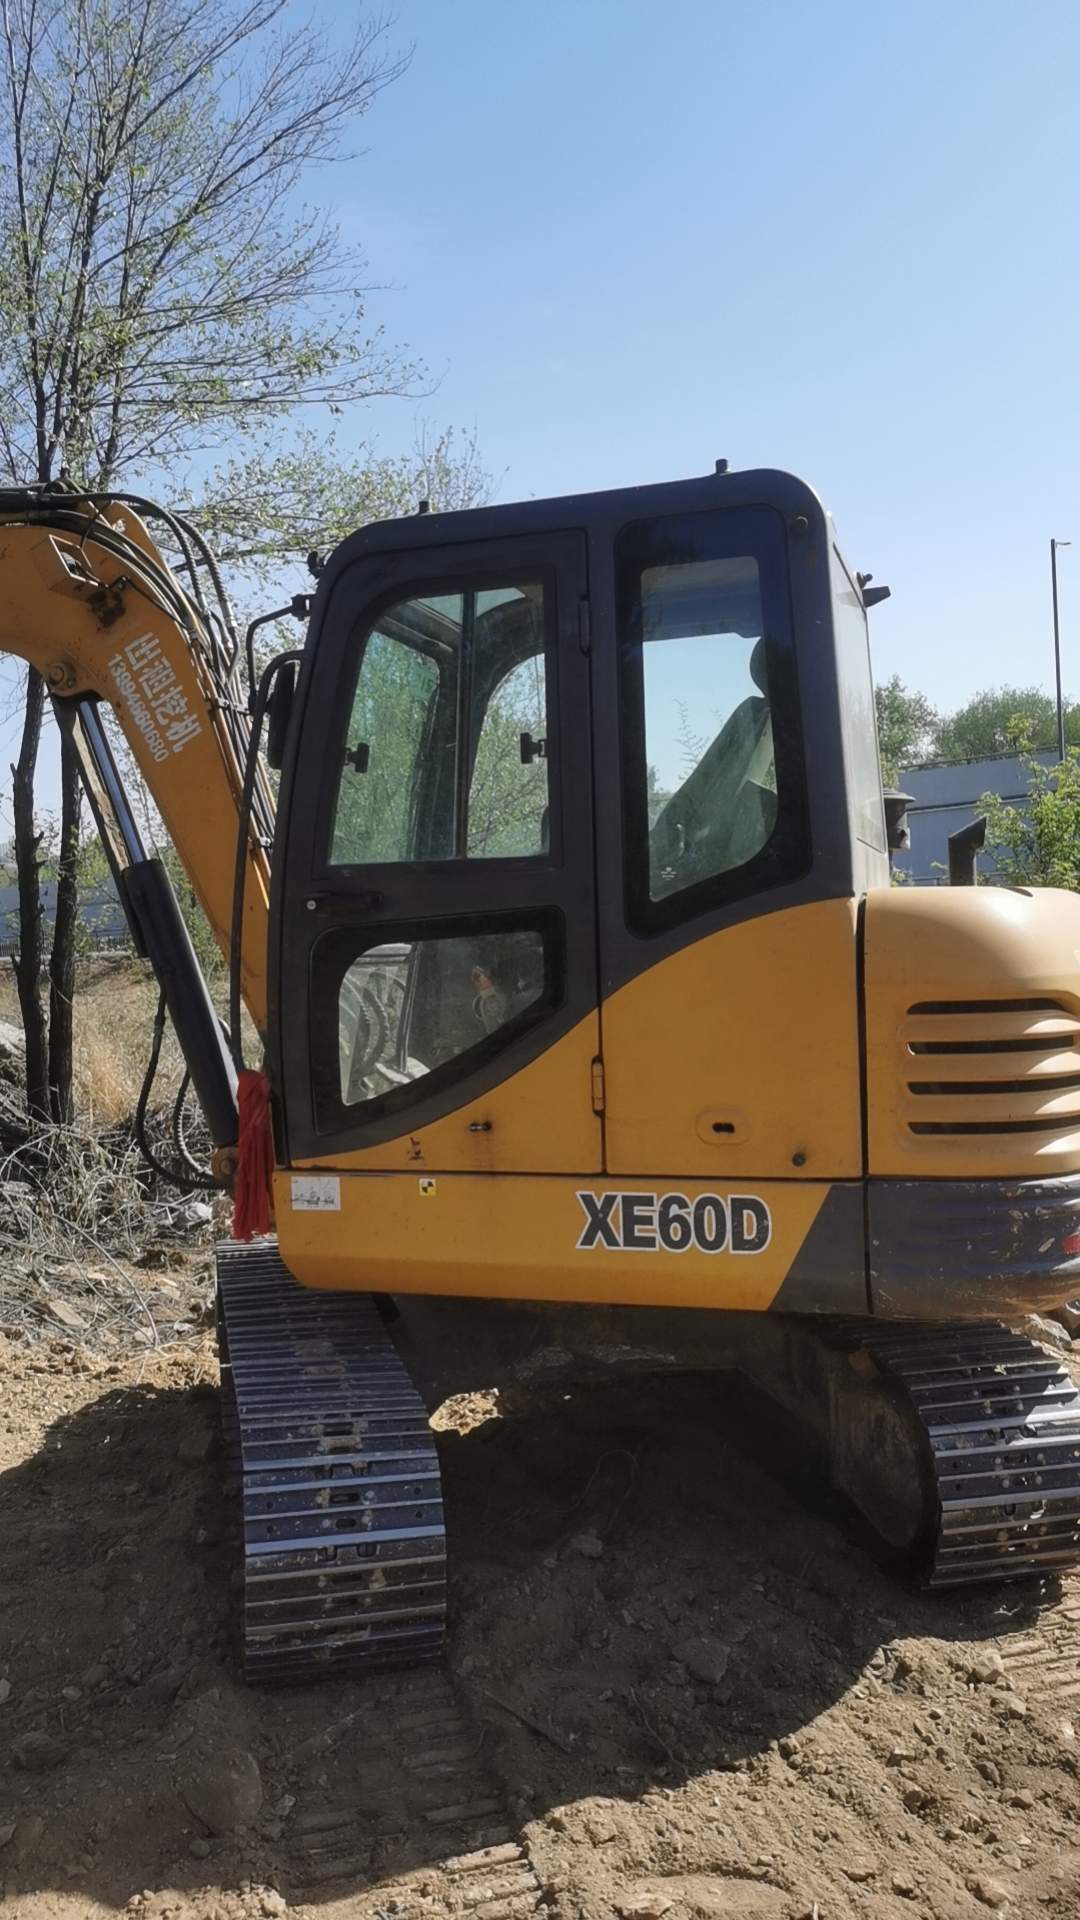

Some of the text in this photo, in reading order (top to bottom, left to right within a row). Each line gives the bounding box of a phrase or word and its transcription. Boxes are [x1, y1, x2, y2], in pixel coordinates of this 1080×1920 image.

[124, 632, 202, 752] 出租挖机
[576, 1191, 772, 1254] XE60D
